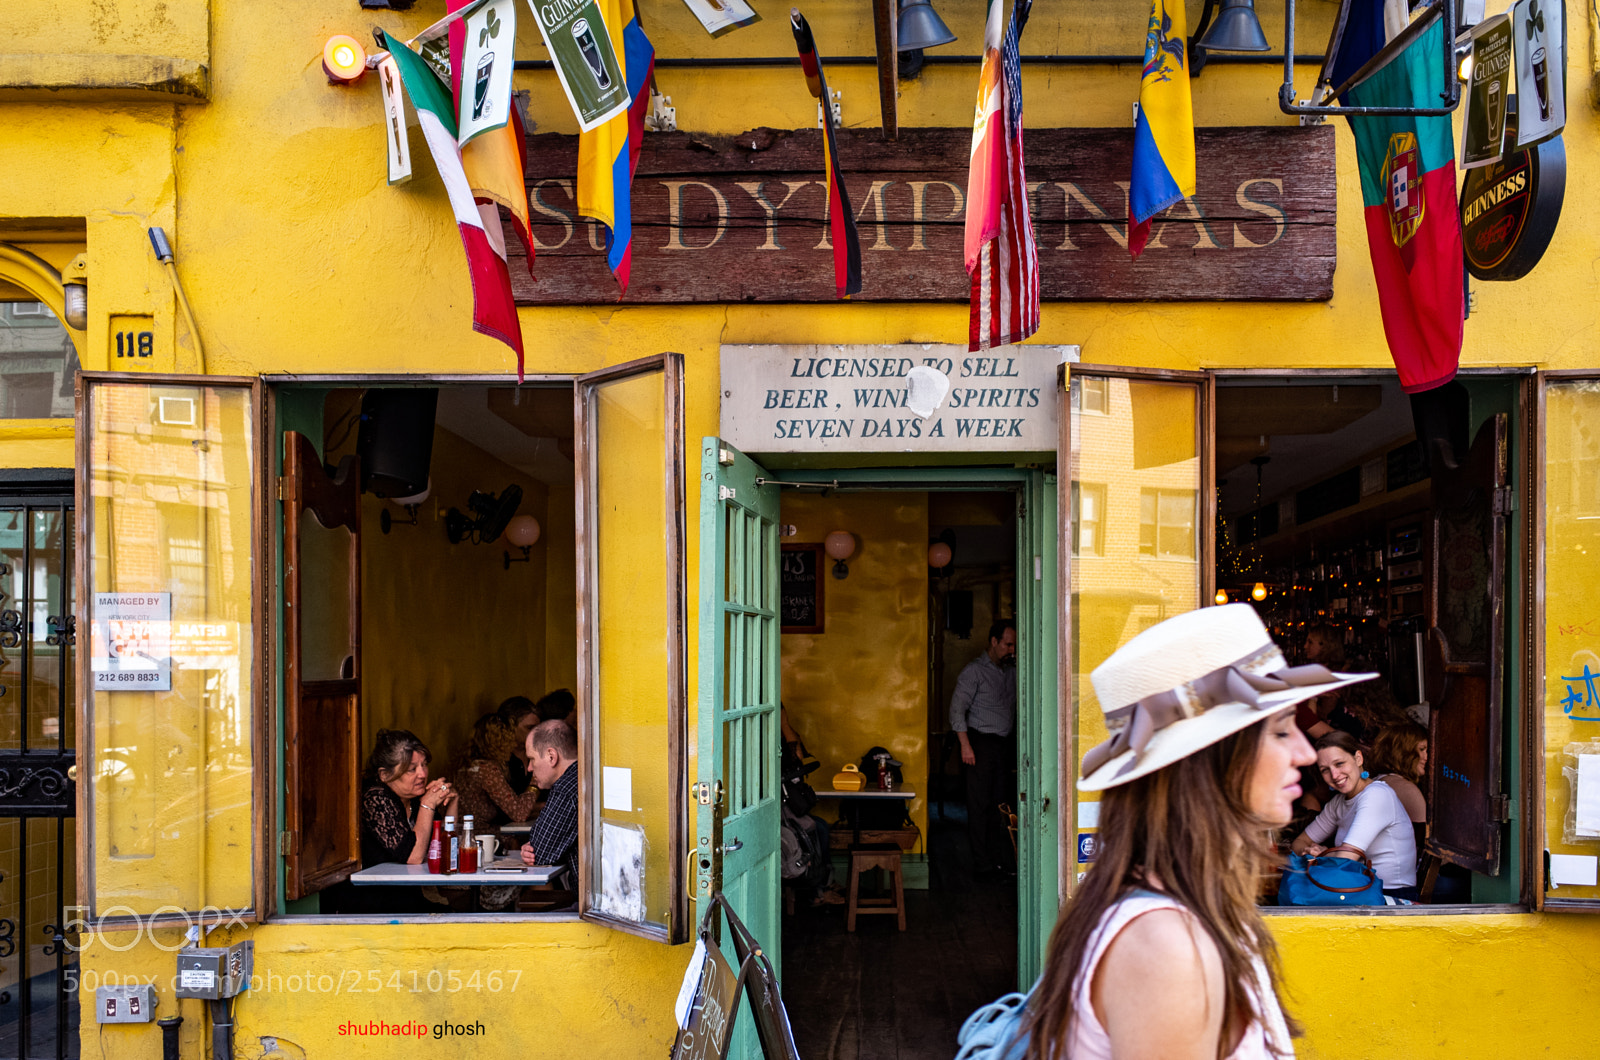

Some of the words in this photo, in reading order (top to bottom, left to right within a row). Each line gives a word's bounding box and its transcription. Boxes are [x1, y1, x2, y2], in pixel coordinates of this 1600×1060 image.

[1464, 170, 1526, 226] GUINNESS
[116, 332, 153, 357] 118
[790, 358, 914, 378] LICENSED
[960, 358, 1019, 378] SELL
[763, 389, 828, 409] BEER
[948, 388, 1040, 408] SPIRITS
[773, 419, 855, 439] SEVEN
[861, 418, 924, 438] DAYS
[929, 418, 945, 438] A
[955, 418, 1025, 438] WEEK
[99, 597, 145, 605] MANAGED
[147, 597, 160, 605] BY
[99, 673, 116, 681] 212
[118, 673, 135, 681] 689
[137, 673, 160, 681] 8833
